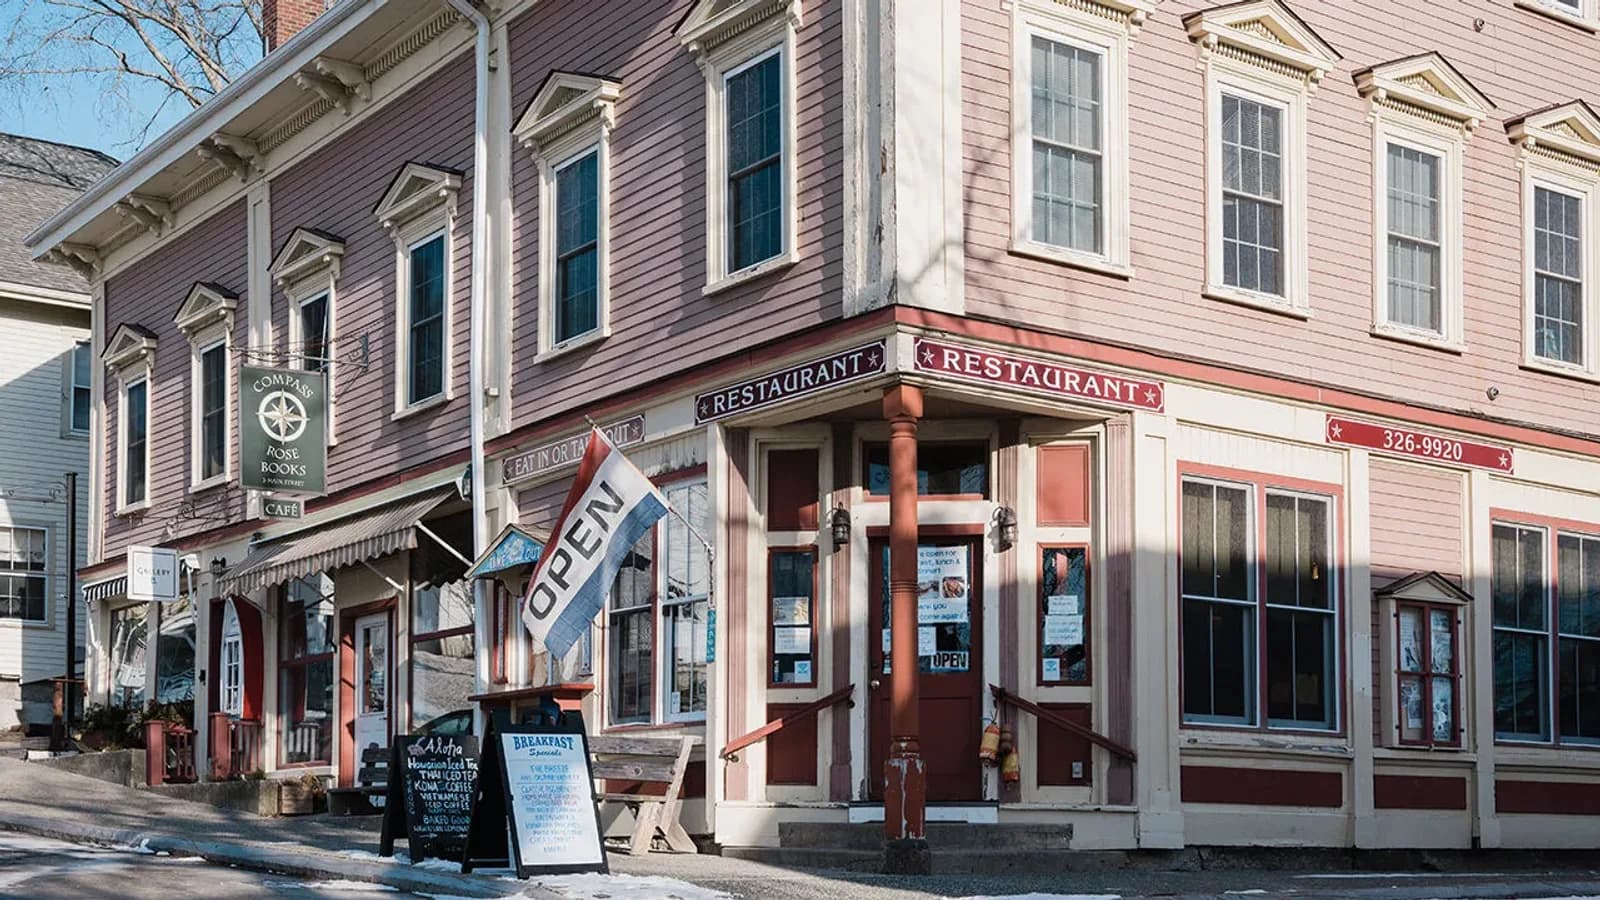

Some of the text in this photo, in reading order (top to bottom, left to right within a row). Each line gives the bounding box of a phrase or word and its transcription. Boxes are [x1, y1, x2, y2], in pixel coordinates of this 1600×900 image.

[712, 352, 863, 413] RESTAURANT
[942, 350, 1141, 402] RESTAURANT
[253, 374, 314, 398] COMPASS
[266, 445, 300, 460] ROSE
[515, 454, 535, 475] EAT
[537, 449, 549, 468] IN
[552, 443, 569, 463] OR
[605, 424, 630, 444] OUT
[1383, 430, 1463, 460] 326-9920
[261, 461, 307, 476] BOOKS
[265, 503, 299, 517] CAFÉ
[528, 480, 625, 620] OPEN
[933, 652, 967, 668] OPEN
[424, 736, 463, 757] Aloha
[512, 735, 574, 751] BREAKFAST
[529, 748, 562, 757] Specials
[447, 757, 465, 770] Iced
[465, 758, 479, 771] Tea
[419, 770, 478, 781] THAI ICED TEA
[414, 780, 474, 793] KONA COFFEE
[420, 792, 470, 801] VIETNAMESE
[423, 814, 449, 825] BAKED
